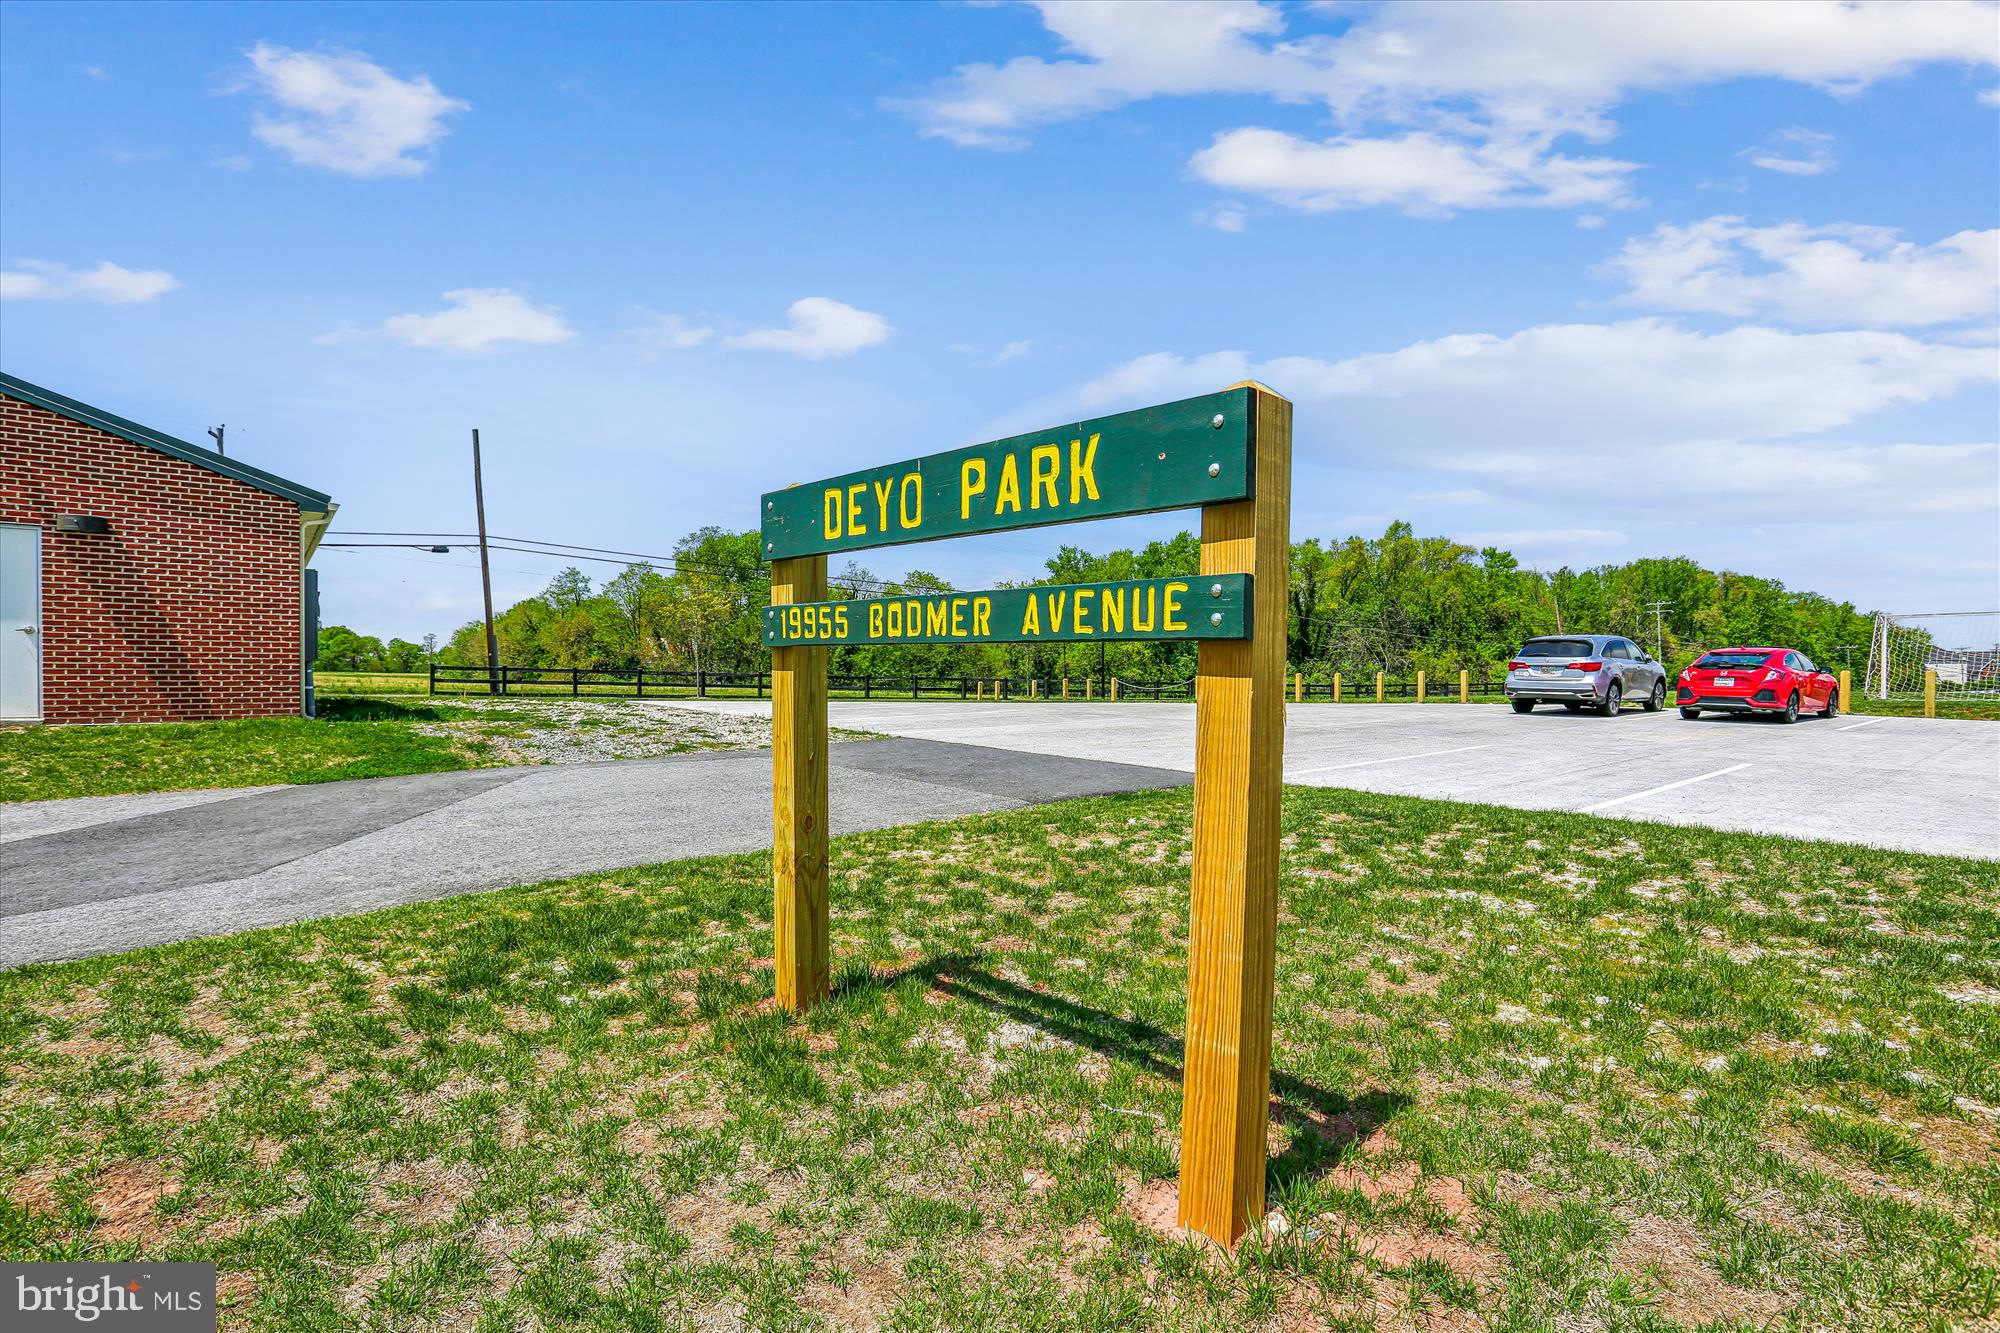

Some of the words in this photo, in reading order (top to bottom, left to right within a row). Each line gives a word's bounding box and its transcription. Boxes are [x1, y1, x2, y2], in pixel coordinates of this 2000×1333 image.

[824, 472, 922, 540] DEYO
[961, 432, 1101, 520] PARK
[781, 605, 849, 639] 19955
[869, 596, 991, 638] BODMER
[1022, 582, 1189, 634] AVENUE
